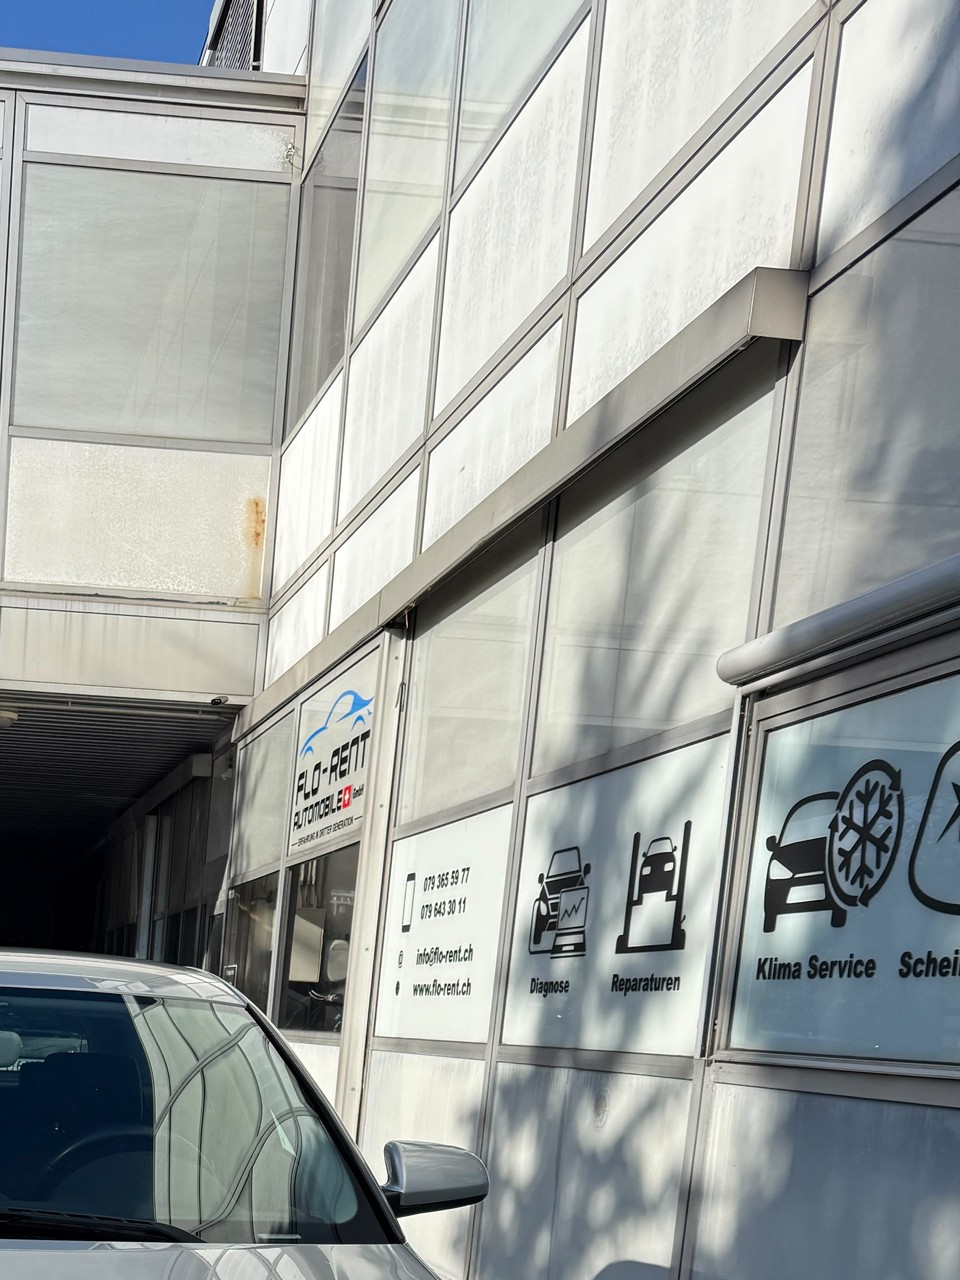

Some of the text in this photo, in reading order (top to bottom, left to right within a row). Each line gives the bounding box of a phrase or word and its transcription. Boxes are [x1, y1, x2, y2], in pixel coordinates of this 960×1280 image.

[295, 729, 371, 806] FLO-RENT
[293, 788, 343, 832] AUTOMOBILE
[423, 867, 470, 892] 079 365 59 77
[420, 896, 467, 920] 079 643 30 11
[416, 943, 474, 967] info@flo-rent.ch
[756, 953, 877, 981] Klima Service
[898, 948, 960, 979] Schei
[412, 977, 472, 997] www.flo-rent.ch
[530, 977, 570, 998] Diagnose
[611, 973, 681, 997] Reparaturen
